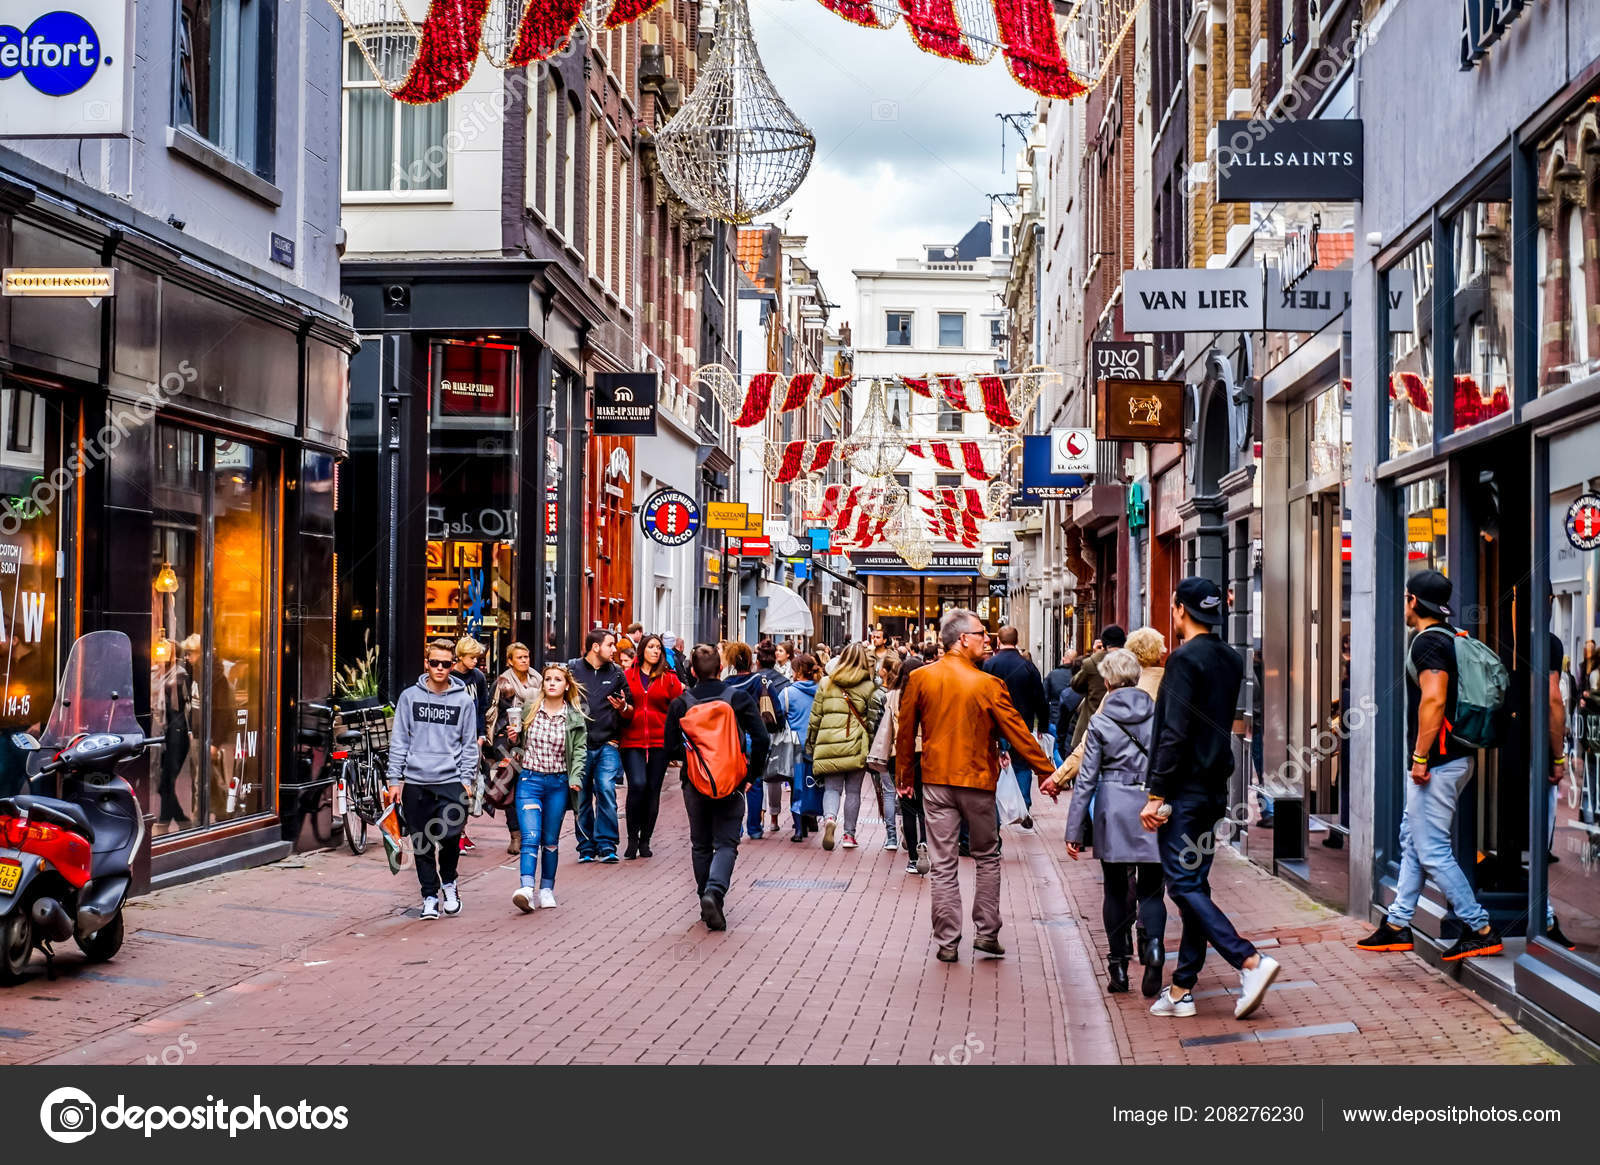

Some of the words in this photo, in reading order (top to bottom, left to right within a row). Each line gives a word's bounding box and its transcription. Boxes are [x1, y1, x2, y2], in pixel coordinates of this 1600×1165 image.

[1230, 152, 1353, 166] ALLSAINTS
[1140, 290, 1186, 310] VAN
[1198, 290, 1249, 309] LIER
[1098, 349, 1140, 367] UNO
[650, 493, 696, 513] SOUVENIRS
[652, 527, 693, 544] TOBACCO
[8, 694, 31, 717] 14-15
